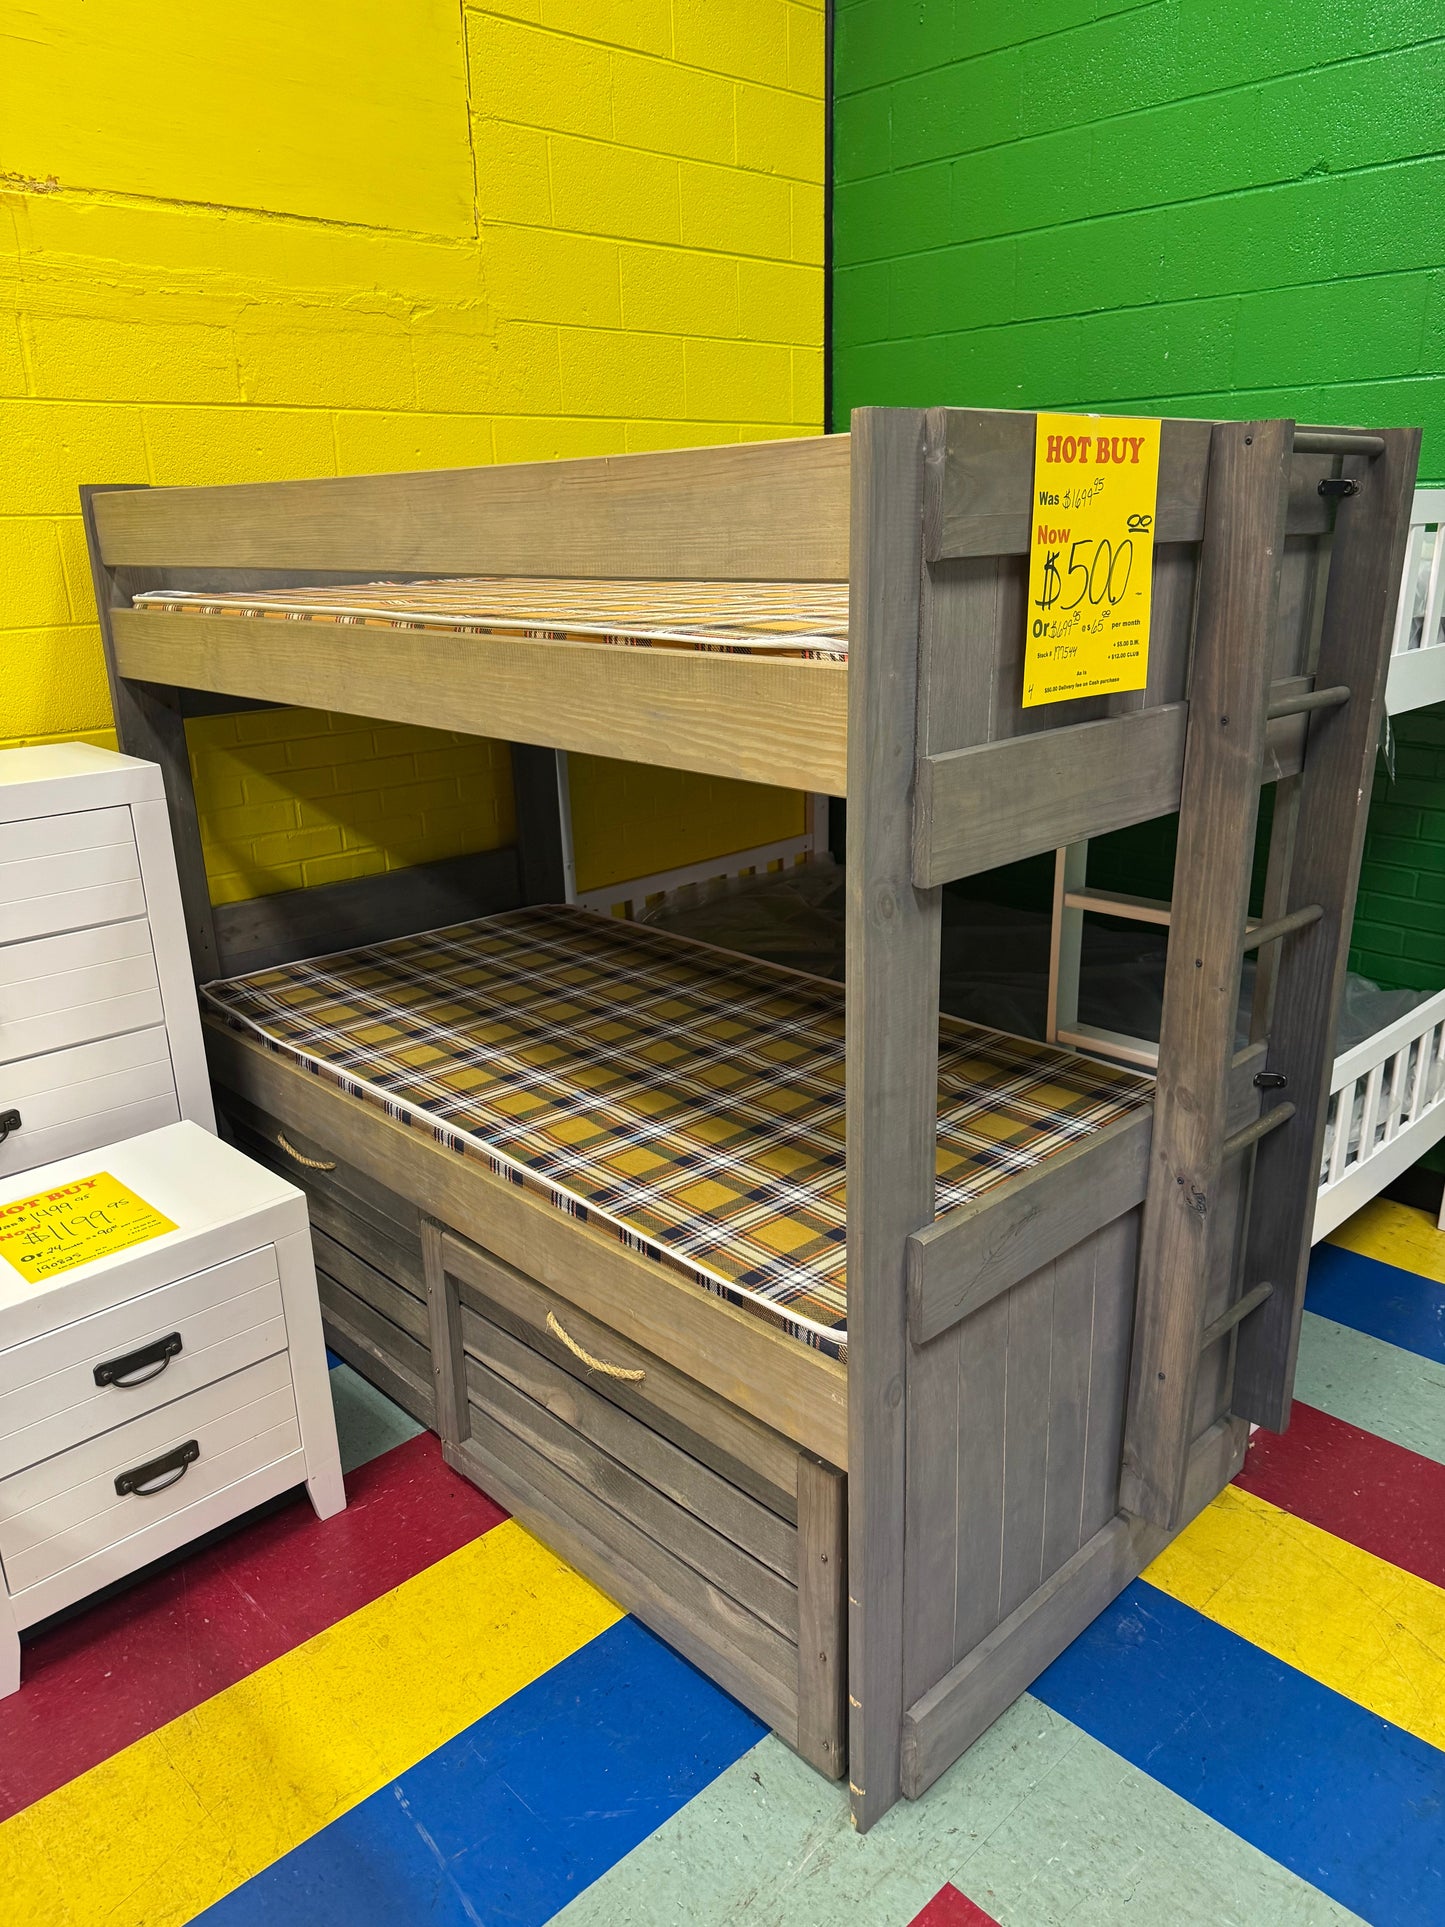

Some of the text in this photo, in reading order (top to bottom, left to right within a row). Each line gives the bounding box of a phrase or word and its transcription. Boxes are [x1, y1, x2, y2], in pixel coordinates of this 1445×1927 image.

[1046, 435, 1145, 464] HOT BUY
[1039, 491, 1060, 506] Was
[1037, 525, 1071, 545] Now
[1032, 619, 1050, 638] Or
[1111, 621, 1121, 630] per
[1122, 619, 1141, 628] month
[1127, 651, 1139, 659] CLUB
[1058, 682, 1074, 693] Delivery
[1100, 677, 1120, 686] purchase
[45, 1179, 97, 1202] BUY
[20, 1252, 43, 1263] Or
